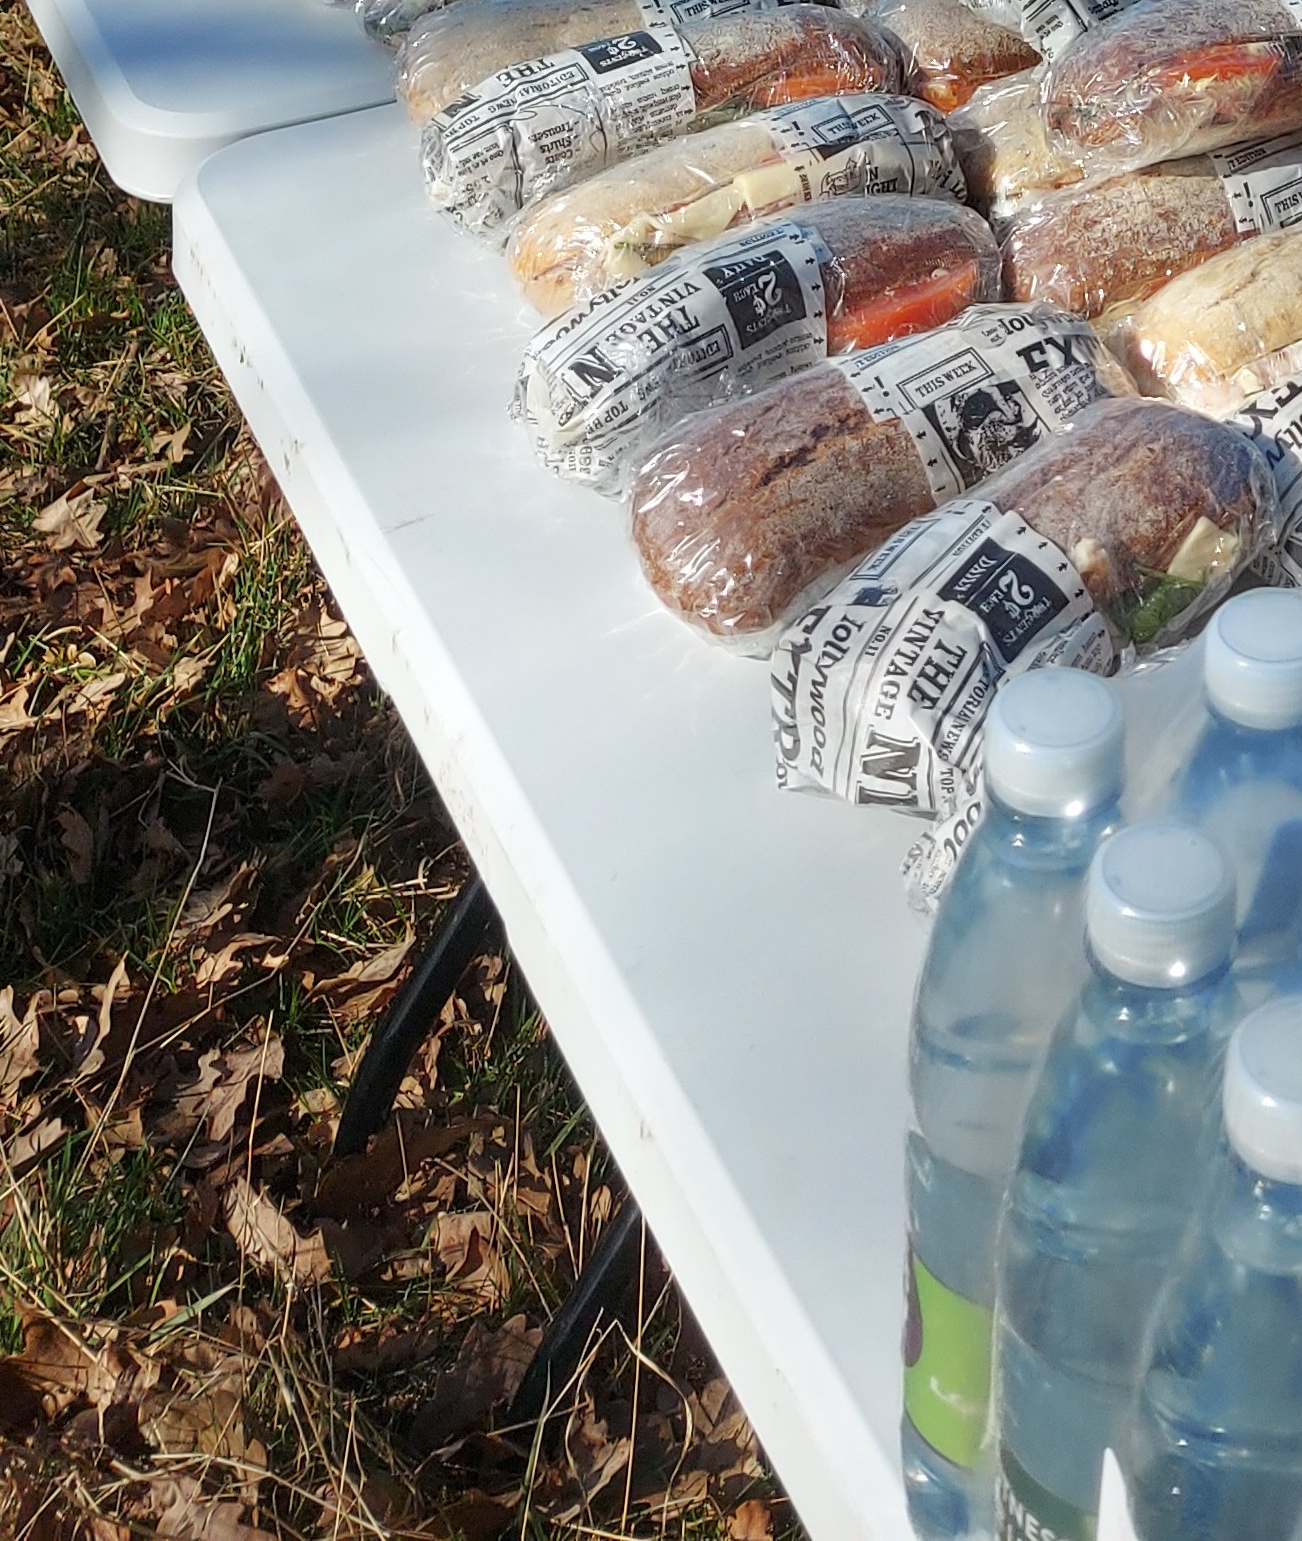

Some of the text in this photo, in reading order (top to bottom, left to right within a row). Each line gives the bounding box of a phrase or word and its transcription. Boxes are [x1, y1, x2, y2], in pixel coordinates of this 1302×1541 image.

[684, 0, 707, 17] THIS
[498, 58, 556, 88] THE
[1274, 193, 1300, 214] THIS
[604, 281, 702, 345] VINTAGE
[638, 305, 700, 354] THE
[915, 359, 977, 399] THIS WEEK
[957, 554, 1000, 593] DAILY
[979, 569, 1035, 620] 2¢ EACH
[873, 607, 946, 721] VINTAGE
[906, 638, 969, 711] THE
[940, 767, 956, 795] TOP
